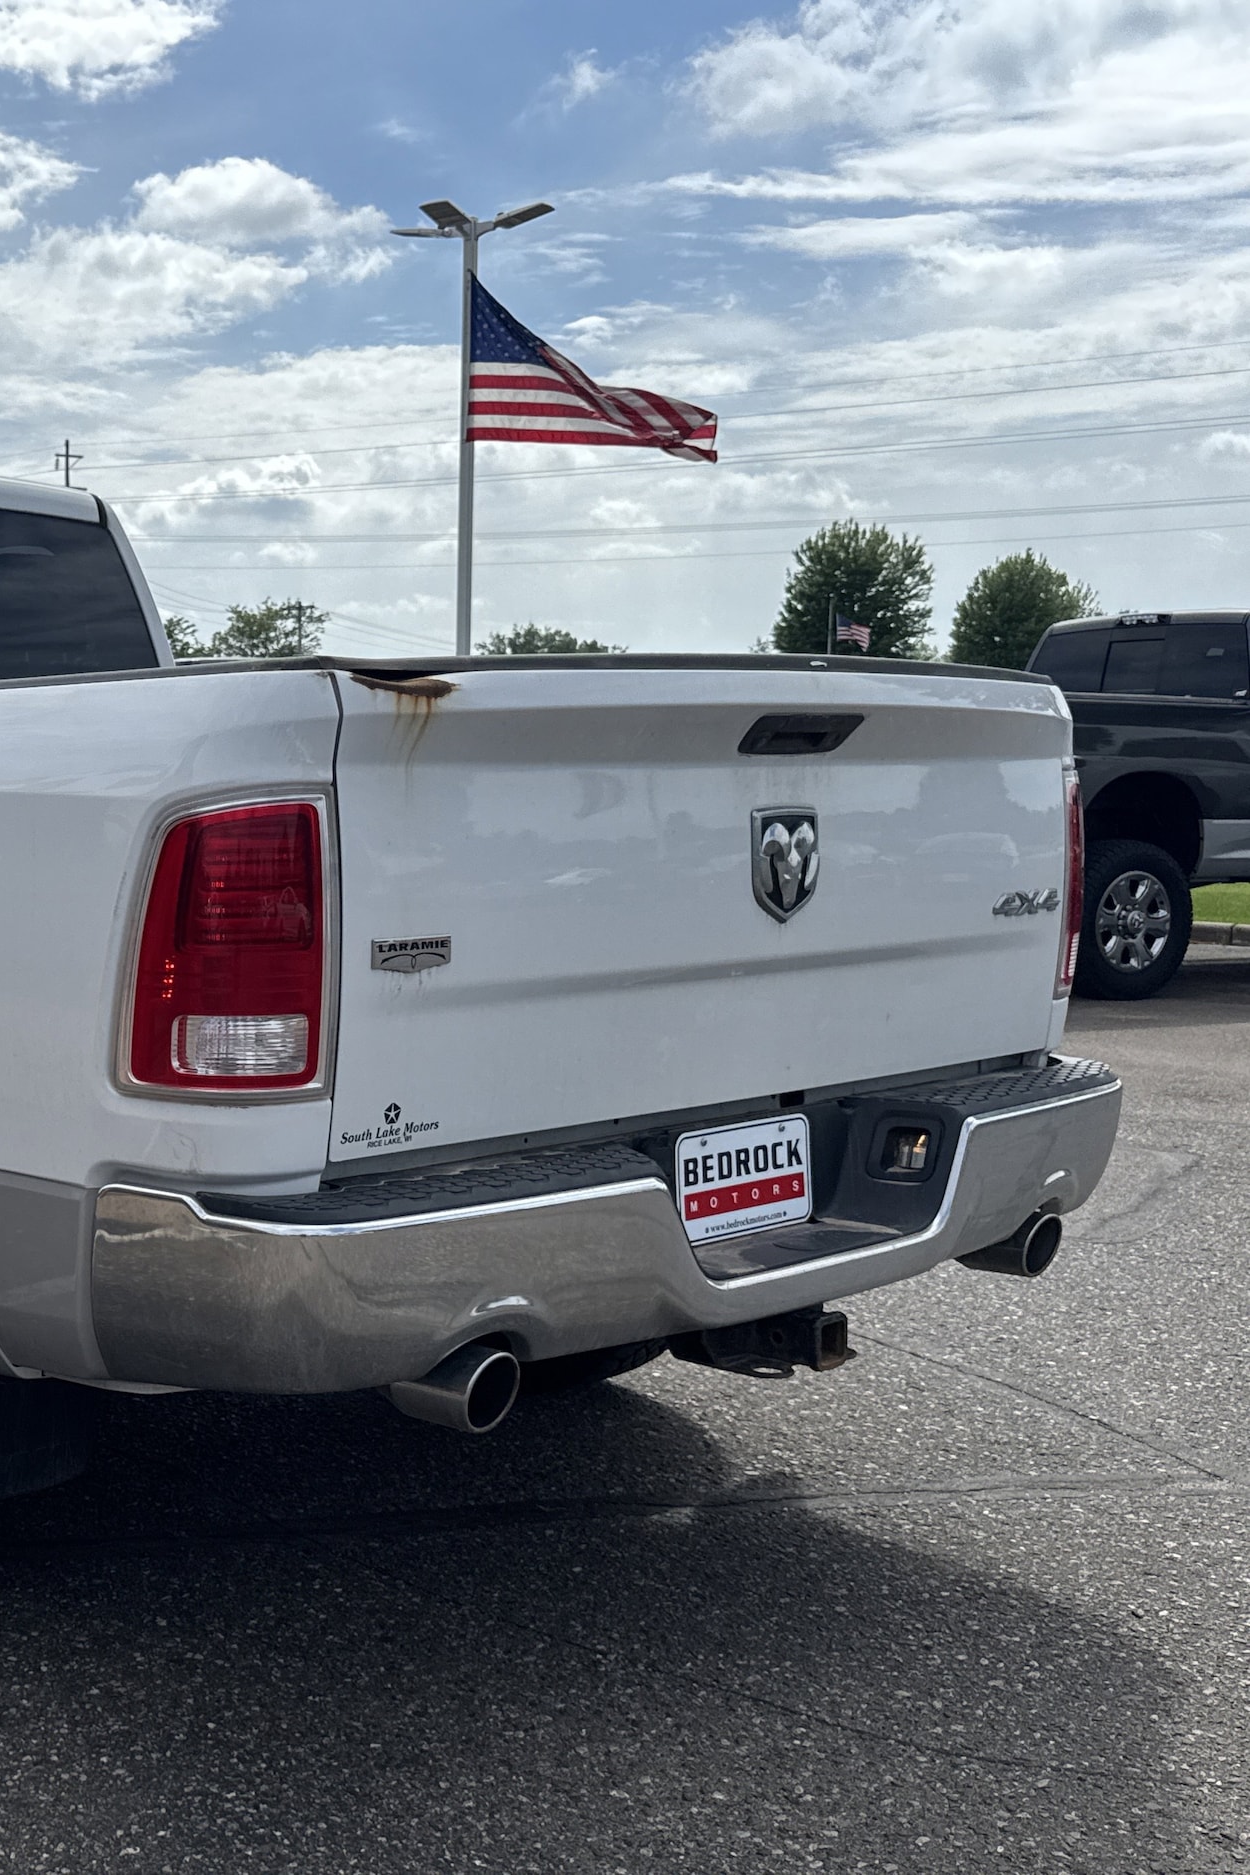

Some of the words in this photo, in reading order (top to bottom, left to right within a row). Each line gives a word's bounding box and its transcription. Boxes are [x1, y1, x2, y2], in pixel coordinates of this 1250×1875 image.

[377, 939, 449, 953] LARAMIE
[340, 1128, 372, 1145] South
[376, 1125, 401, 1139] Lake
[404, 1121, 440, 1135] Motors
[367, 1139, 383, 1149] RICE
[683, 1139, 803, 1187] BEDROCK
[690, 1180, 800, 1212] MOTORS
[710, 1211, 783, 1233] www.bedrockmotors.com
